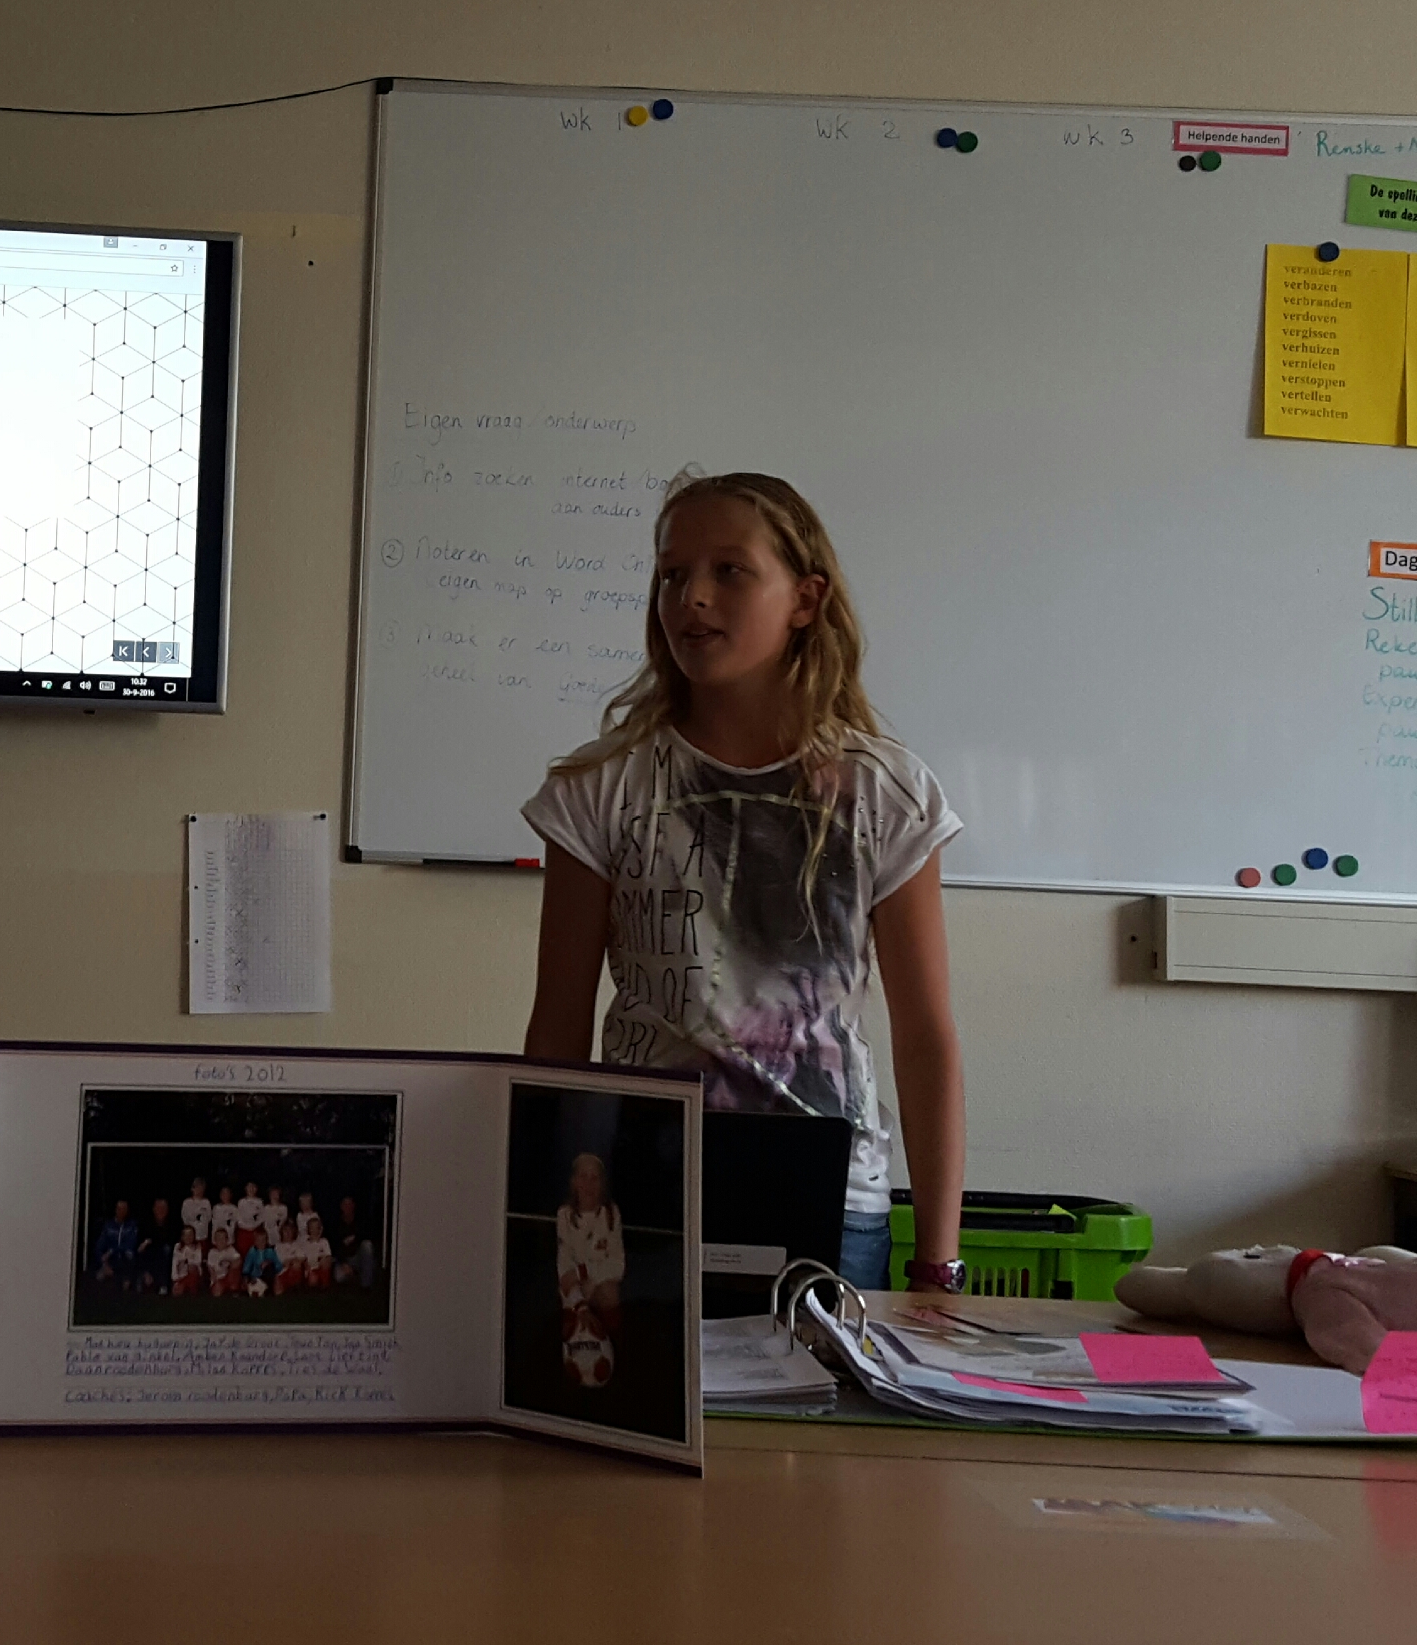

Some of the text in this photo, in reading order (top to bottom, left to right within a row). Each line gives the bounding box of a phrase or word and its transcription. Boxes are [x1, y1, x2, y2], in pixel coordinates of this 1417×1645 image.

[882, 119, 902, 140] 2
[1119, 127, 1136, 146] 3
[1187, 129, 1281, 145] Helpende handen
[1316, 129, 1387, 157] Renske
[1369, 184, 1384, 198] De
[1378, 208, 1397, 219] van
[1283, 265, 1353, 278] veranderen
[1283, 280, 1337, 293] verbazen
[1283, 296, 1353, 310] verbranden
[1282, 312, 1337, 325] verdoven
[1282, 328, 1337, 342] vergissen
[1282, 342, 1340, 356] verhuizen
[1282, 359, 1336, 372] vernielen
[1281, 375, 1346, 390] verstoppen
[1281, 391, 1332, 403] vertellen
[1280, 406, 1349, 420] verwachten
[405, 402, 463, 446] Eigen
[544, 411, 636, 441] onderwerp
[555, 549, 605, 571] Word
[244, 1063, 288, 1082] 2012
